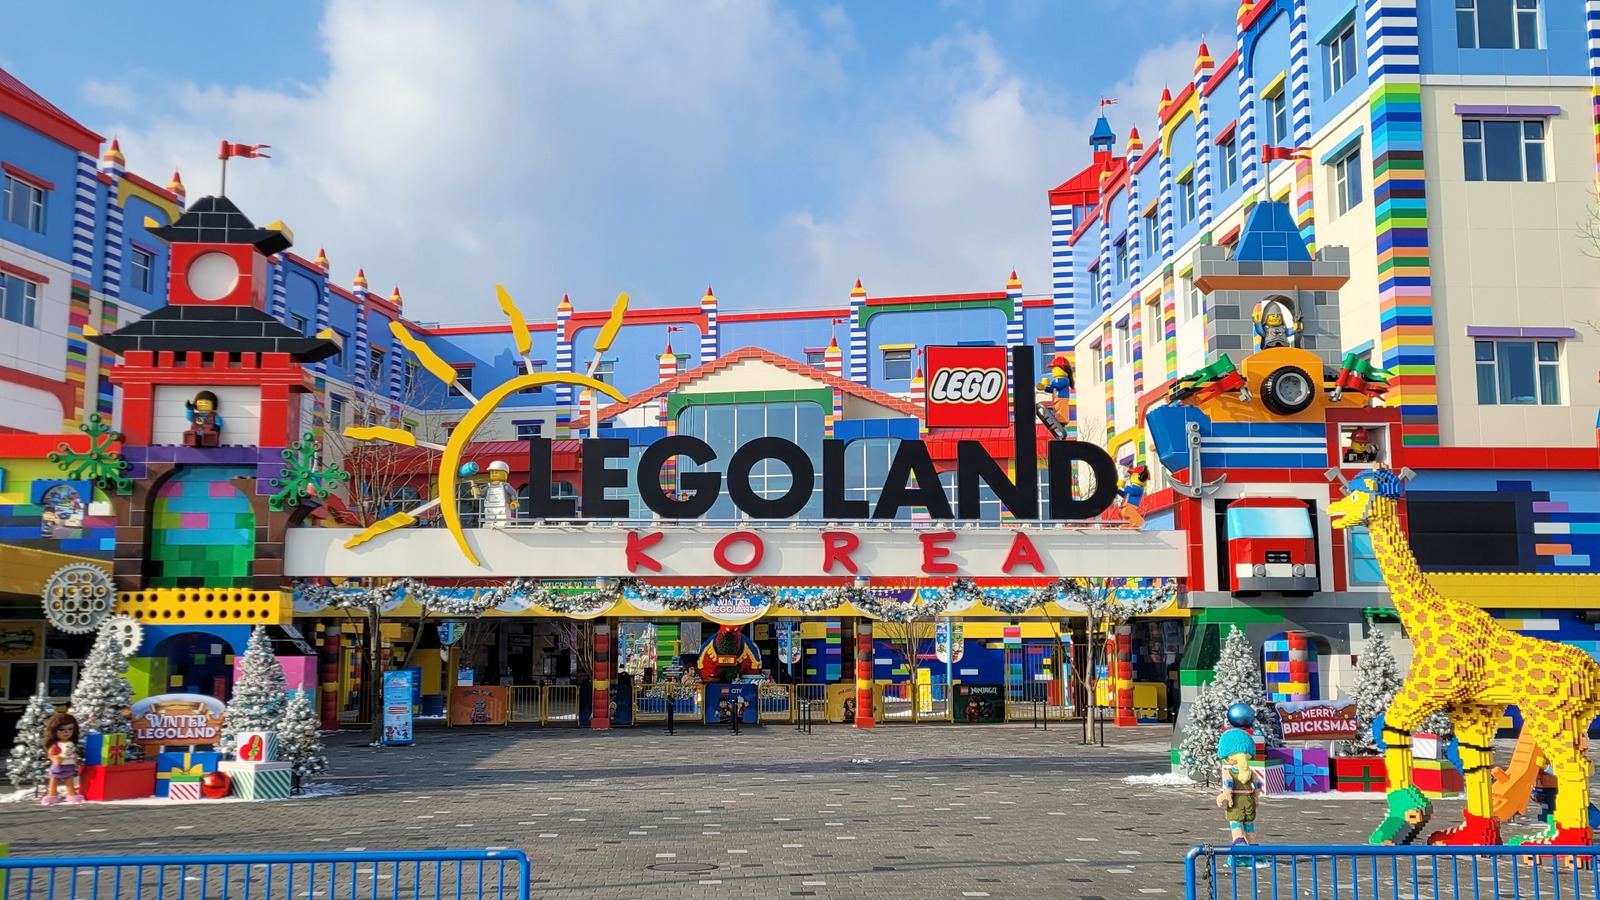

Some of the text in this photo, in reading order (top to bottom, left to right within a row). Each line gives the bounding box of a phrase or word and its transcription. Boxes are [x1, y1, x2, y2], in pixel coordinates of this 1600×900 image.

[932, 369, 1003, 402] LEGO
[529, 345, 1118, 520] LEGOLAND
[625, 530, 1046, 574] KOREA
[717, 598, 750, 606] WINTER
[710, 605, 756, 613] LEGOLAND
[970, 686, 998, 695] NINJAGO
[1301, 708, 1336, 719] MERRY
[146, 713, 207, 728] WINTER
[1284, 720, 1357, 734] BRICKSMAS
[137, 727, 216, 739] LEGOLAND
